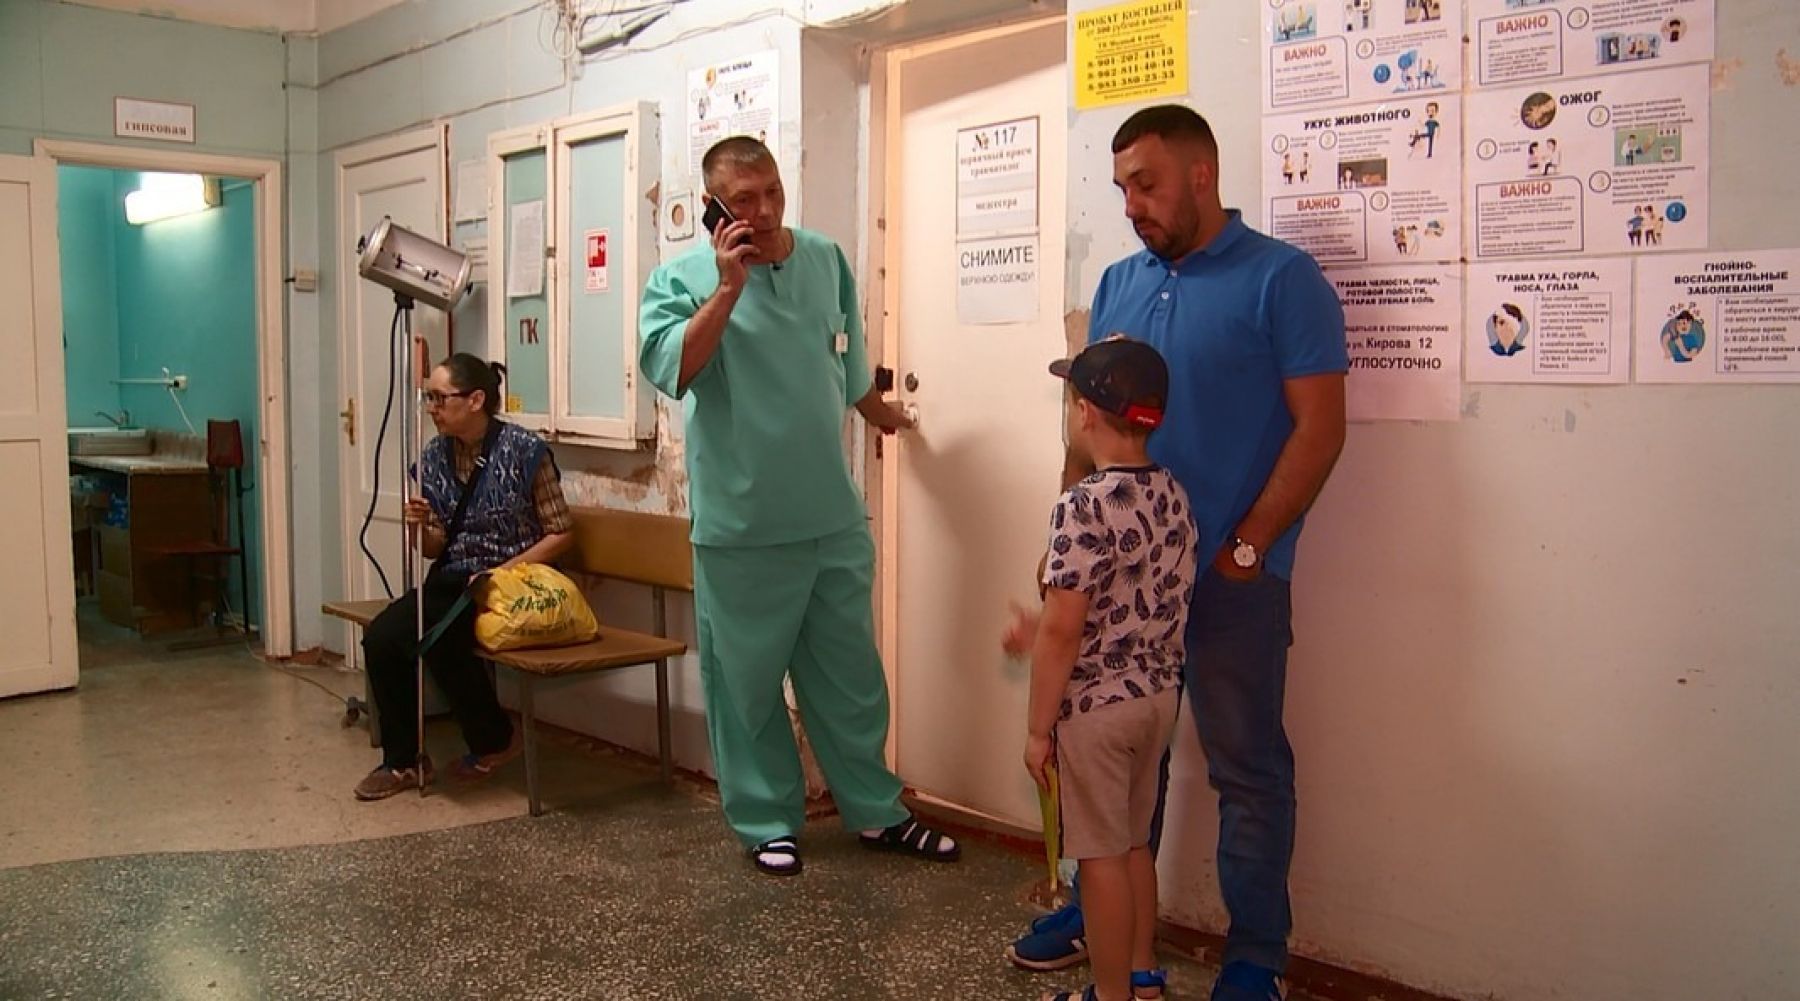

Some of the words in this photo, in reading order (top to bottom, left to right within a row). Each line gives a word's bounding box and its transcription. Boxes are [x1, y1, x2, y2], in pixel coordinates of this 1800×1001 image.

[1496, 15, 1548, 34] ВАЖНО
[1284, 45, 1326, 62] ВАЖНО
[1559, 91, 1602, 107] ОЖОГ
[1304, 118, 1331, 130] УКУС
[1335, 108, 1411, 127] ЖИВОТНОГО
[994, 126, 1017, 146] 117
[1500, 181, 1552, 198] ВАЖНО
[1296, 197, 1340, 212] ВАЖНО
[960, 245, 1034, 269] СНИМИТЕ
[1704, 261, 1756, 272] ГНОЙНО-
[1336, 280, 1368, 288] ТРАВМА
[1369, 278, 1410, 287] ЧЕЛЮСТИ,
[1413, 278, 1440, 286] ЛИЦА,
[1496, 274, 1535, 282] ТРАВМА
[1538, 273, 1560, 282] УХА,
[1563, 272, 1600, 281] ГОРЛА,
[1674, 272, 1788, 284] ВОСПАЛИТЕЛЬНЫЕ
[1346, 288, 1384, 297] РОТОВОЙ
[1386, 287, 1428, 296] ПОЛОСТИ,
[1513, 284, 1544, 293] НОСА,
[1546, 282, 1579, 292] ГЛАЗА
[1687, 284, 1774, 295] ЗАБОЛЕВАНИЯ
[1378, 297, 1409, 305] ЗУБНАЯ
[1412, 296, 1435, 304] БОЛЬ
[520, 318, 539, 344] ПК
[1352, 342, 1364, 350] ул.
[1366, 338, 1410, 351] Кирова
[1419, 338, 1432, 349] 12
[1348, 357, 1442, 370] УГЛОСУТОЧНО
